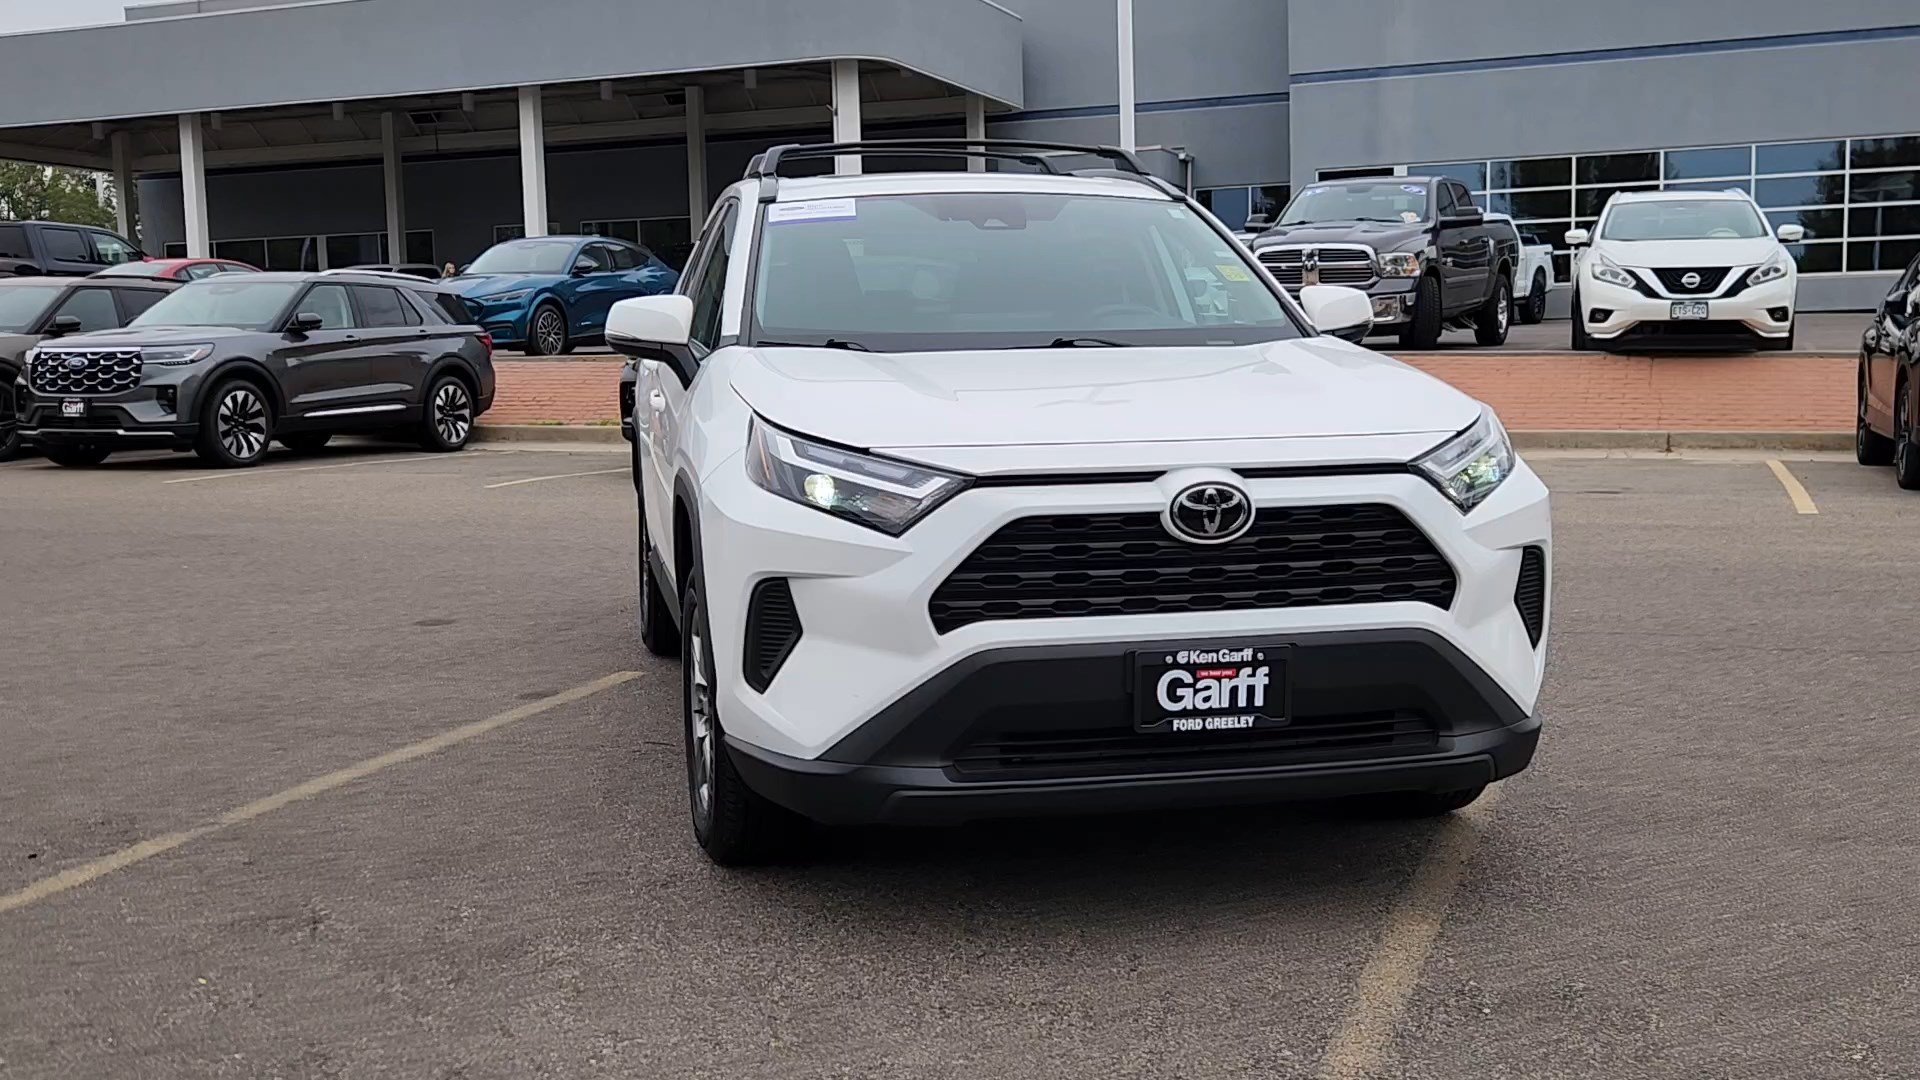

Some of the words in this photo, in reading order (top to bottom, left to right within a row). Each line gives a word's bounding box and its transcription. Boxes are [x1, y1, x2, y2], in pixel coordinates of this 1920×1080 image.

[1156, 666, 1270, 712] Garff
[1173, 719, 1203, 731] FORD
[1205, 716, 1255, 730] GREELEY
